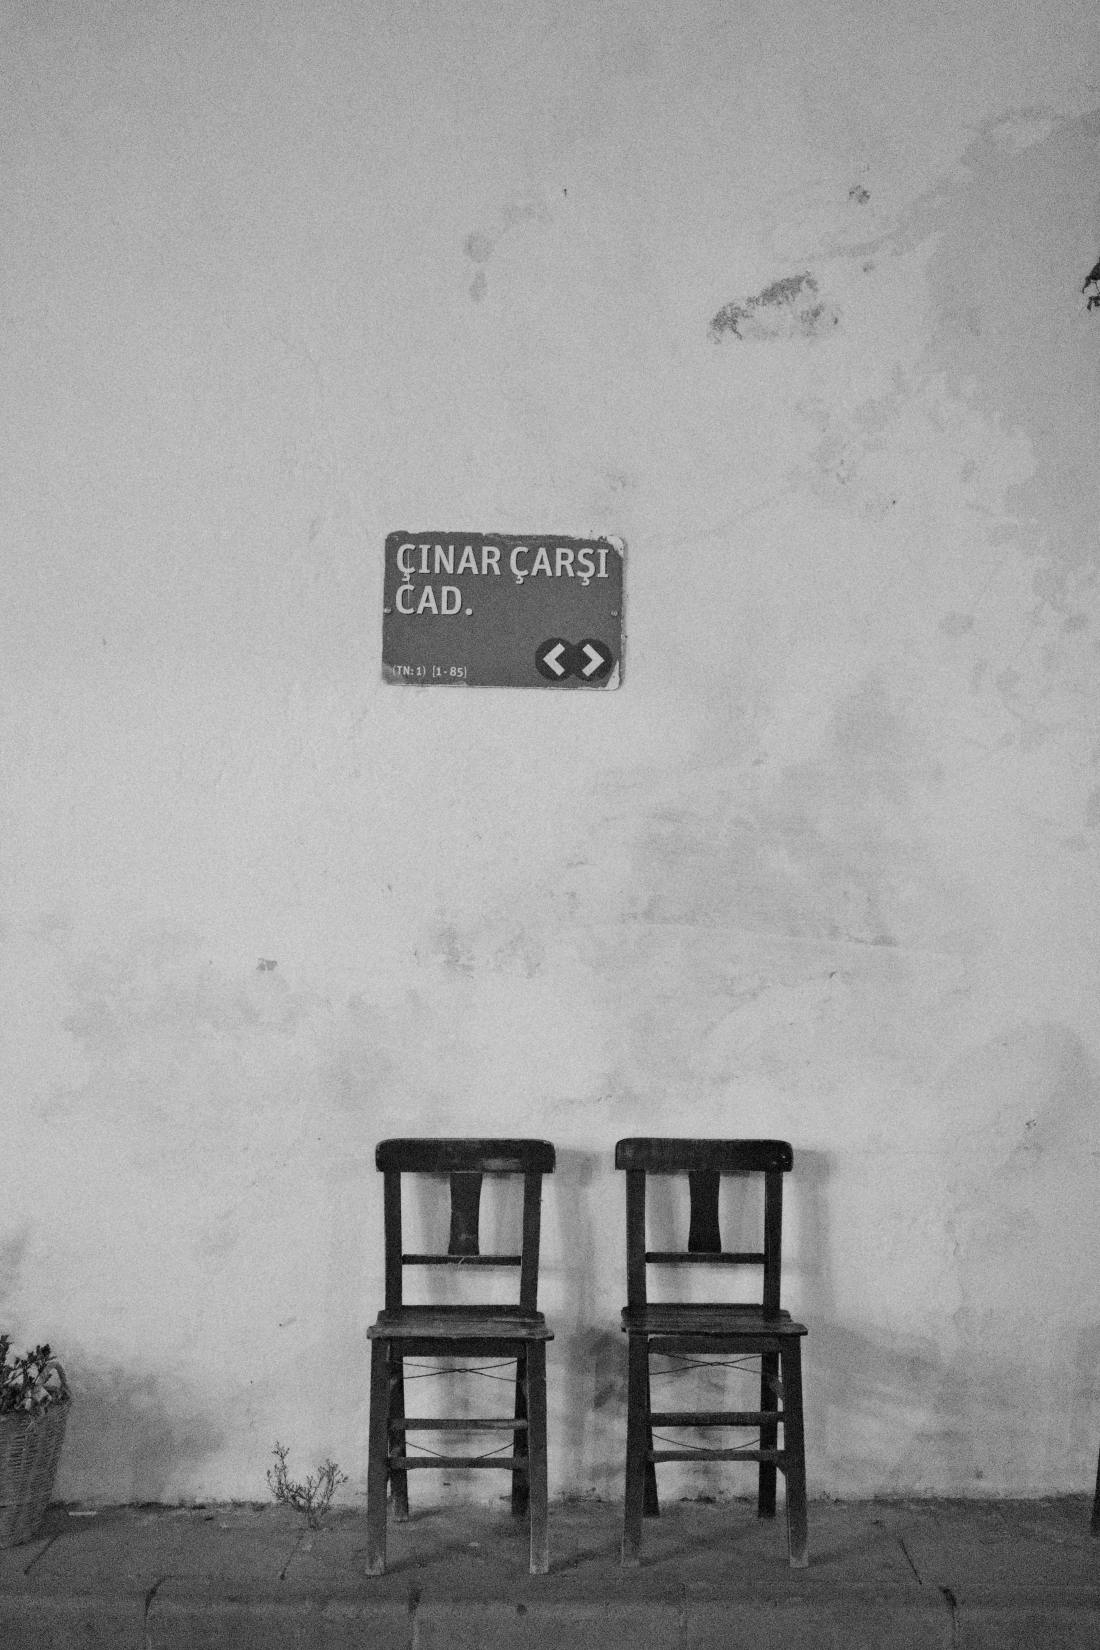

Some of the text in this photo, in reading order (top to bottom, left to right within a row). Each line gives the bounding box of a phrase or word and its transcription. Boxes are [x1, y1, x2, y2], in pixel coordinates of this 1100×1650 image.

[396, 543, 610, 586] ÇINAR ÇARŞI
[395, 584, 474, 616] CAD.
